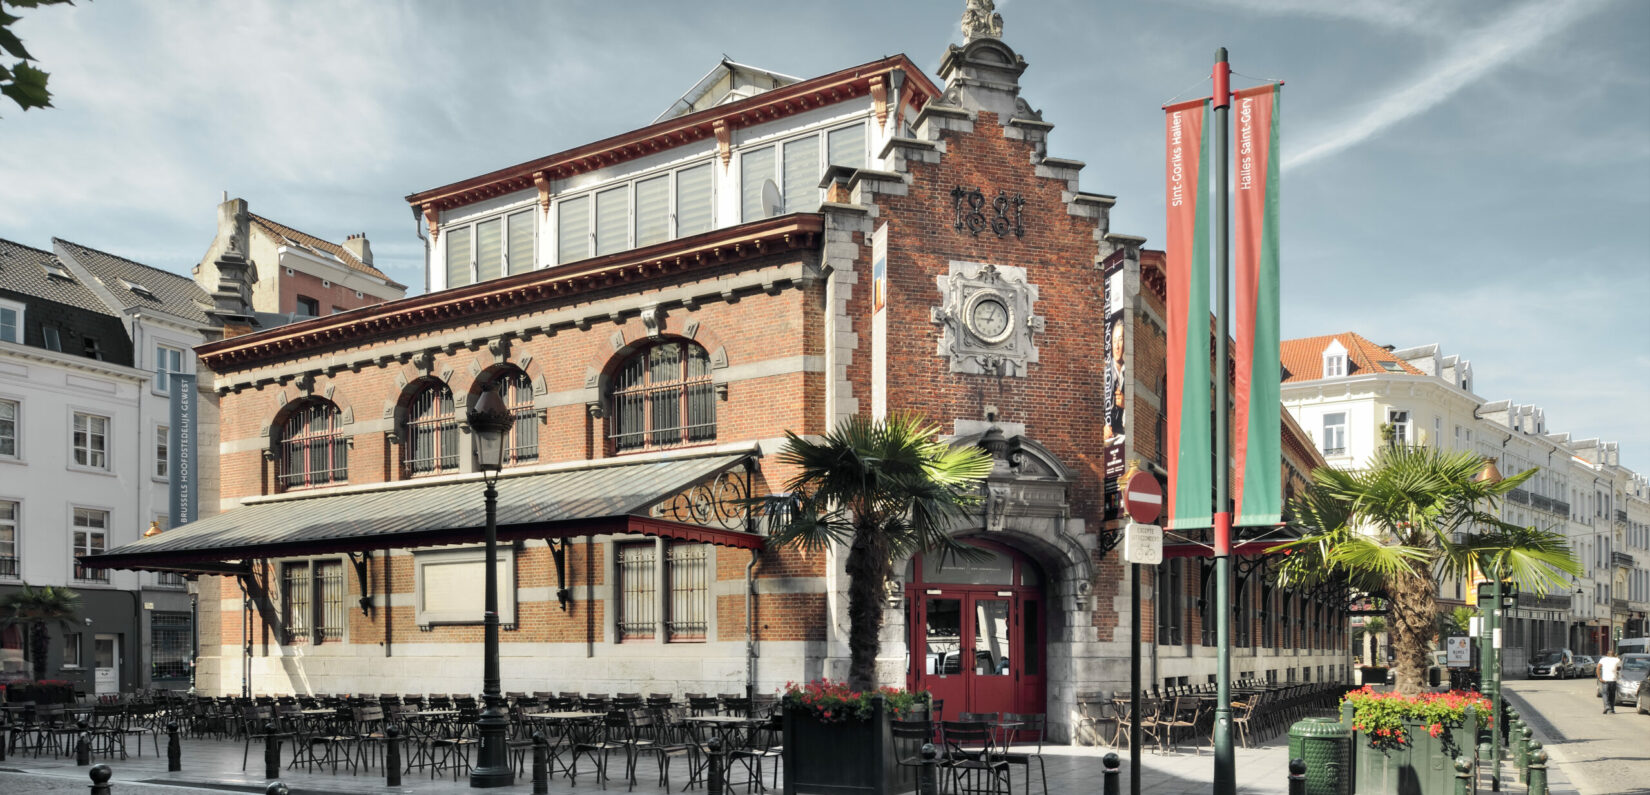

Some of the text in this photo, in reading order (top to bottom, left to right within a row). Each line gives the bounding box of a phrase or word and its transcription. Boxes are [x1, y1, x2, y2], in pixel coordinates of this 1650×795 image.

[1172, 111, 1183, 207] Sint-Goriks Hallen
[1240, 97, 1253, 190] Halles Saint-Géry
[950, 184, 1026, 241] 1881
[1104, 322, 1112, 350] SON
[1104, 352, 1112, 364] &
[180, 379, 191, 523] BRUSSELS HOOFDSTEDELIJK GEWEST
